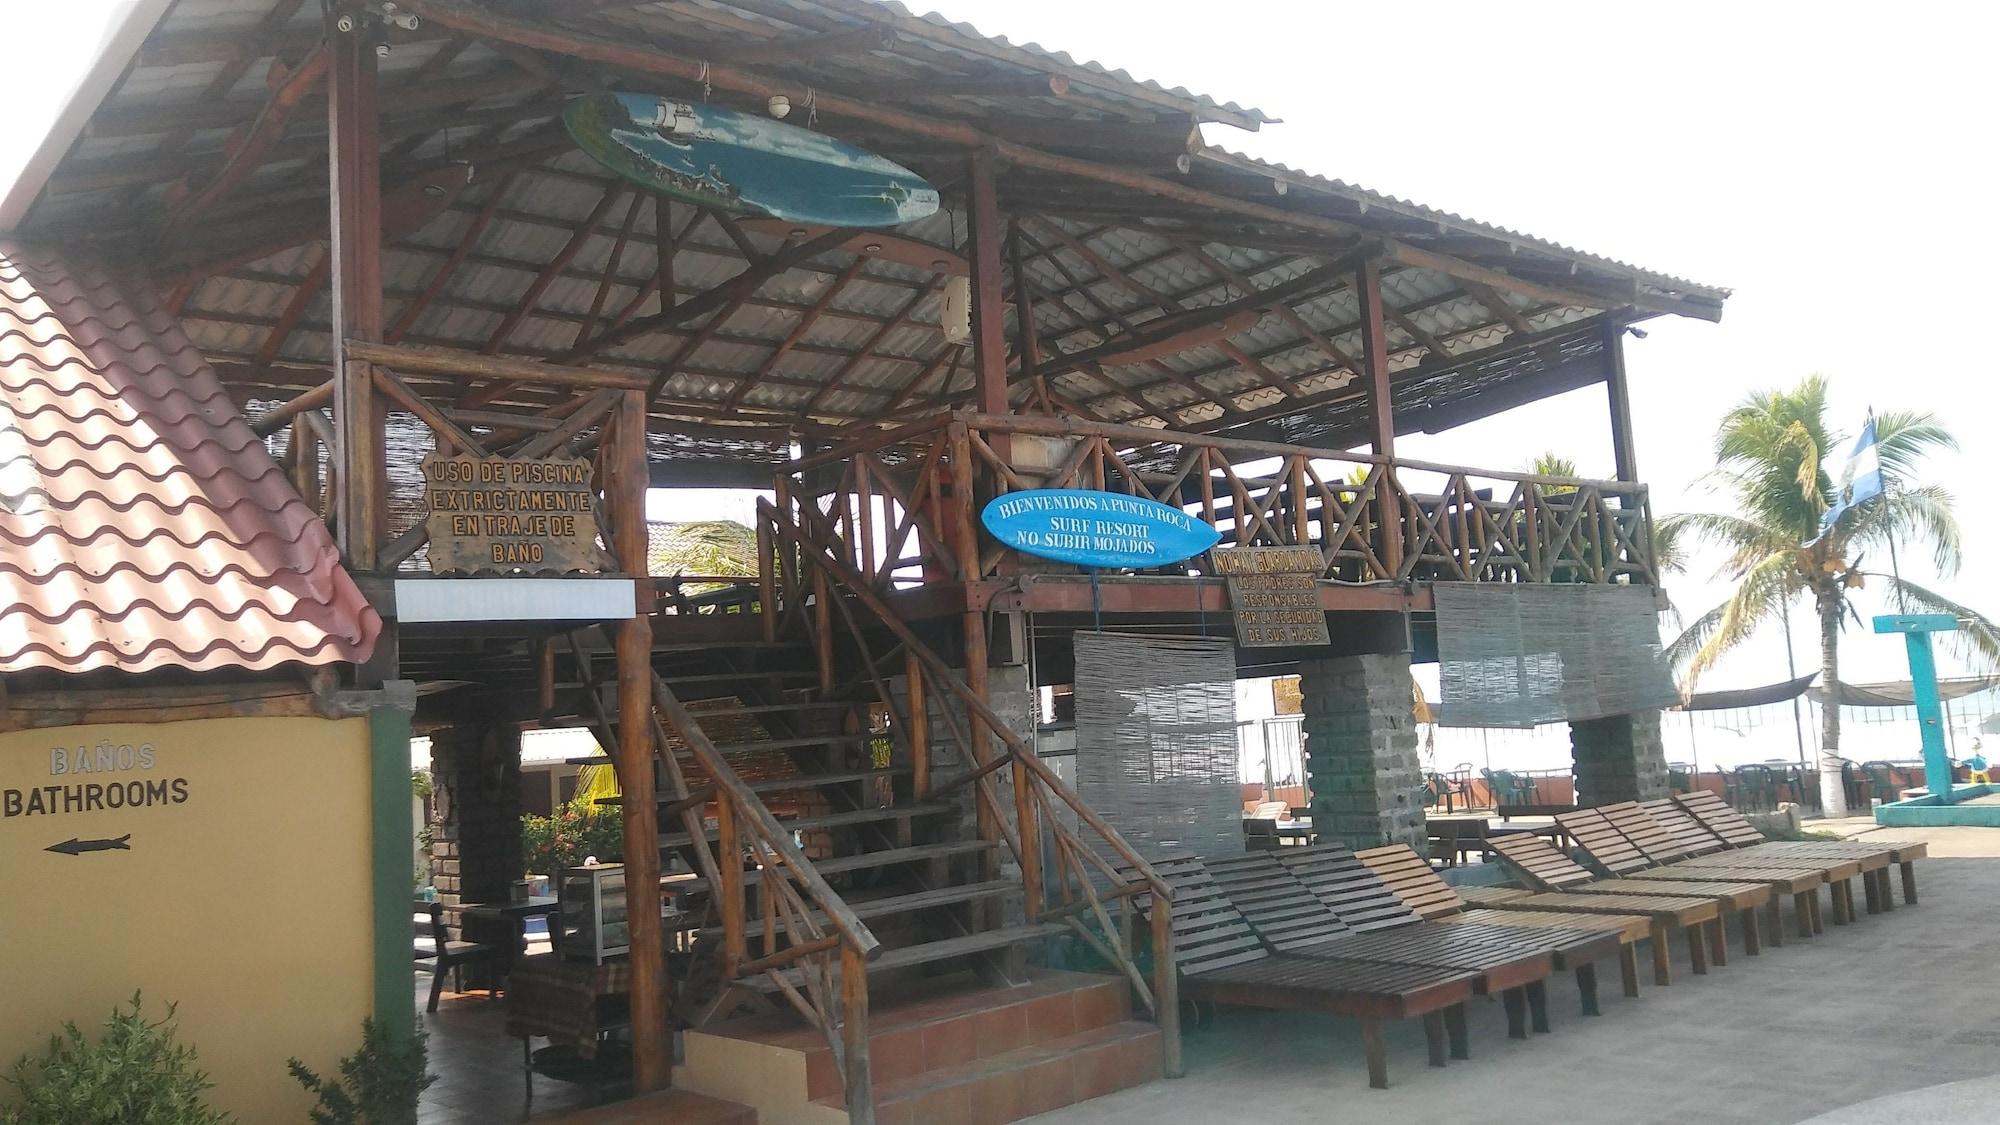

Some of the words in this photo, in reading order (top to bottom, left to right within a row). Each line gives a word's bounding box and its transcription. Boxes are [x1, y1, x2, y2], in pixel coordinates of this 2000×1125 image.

[433, 461, 473, 482] USO
[479, 462, 505, 483] DE
[512, 463, 584, 484] PISCINA
[431, 489, 591, 511] EXTRICTAMENTE
[452, 514, 479, 536] EN
[484, 514, 547, 536] TRAJE
[551, 515, 575, 536] DE
[998, 496, 1098, 520] BIENVENIDOS
[1101, 498, 1111, 511] A
[1111, 498, 1154, 519] PUNTA
[1156, 508, 1192, 532] ROCA
[1049, 517, 1092, 533] SURF
[1096, 521, 1150, 538] RESORT
[491, 540, 543, 563] BAÑO
[1017, 530, 1039, 546] NO
[1044, 533, 1090, 550] SUBIR
[1093, 537, 1155, 554] MOJADOS
[1214, 552, 1233, 573] NO
[1231, 551, 1255, 573] HAY
[1237, 576, 1256, 590] LOS
[1258, 575, 1295, 590] PADRES
[1297, 574, 1316, 590] SON
[1243, 594, 1316, 608] RESPONSABLES
[1239, 611, 1258, 624] POR
[1260, 611, 1272, 624] LA
[1273, 609, 1324, 624] SEGURIDAD
[1247, 629, 1262, 642] DE
[1266, 628, 1286, 641] SUS
[1290, 628, 1321, 641] HIJOS
[50, 739, 156, 775] BAÑOS
[3, 778, 188, 817] BATHROOMS
